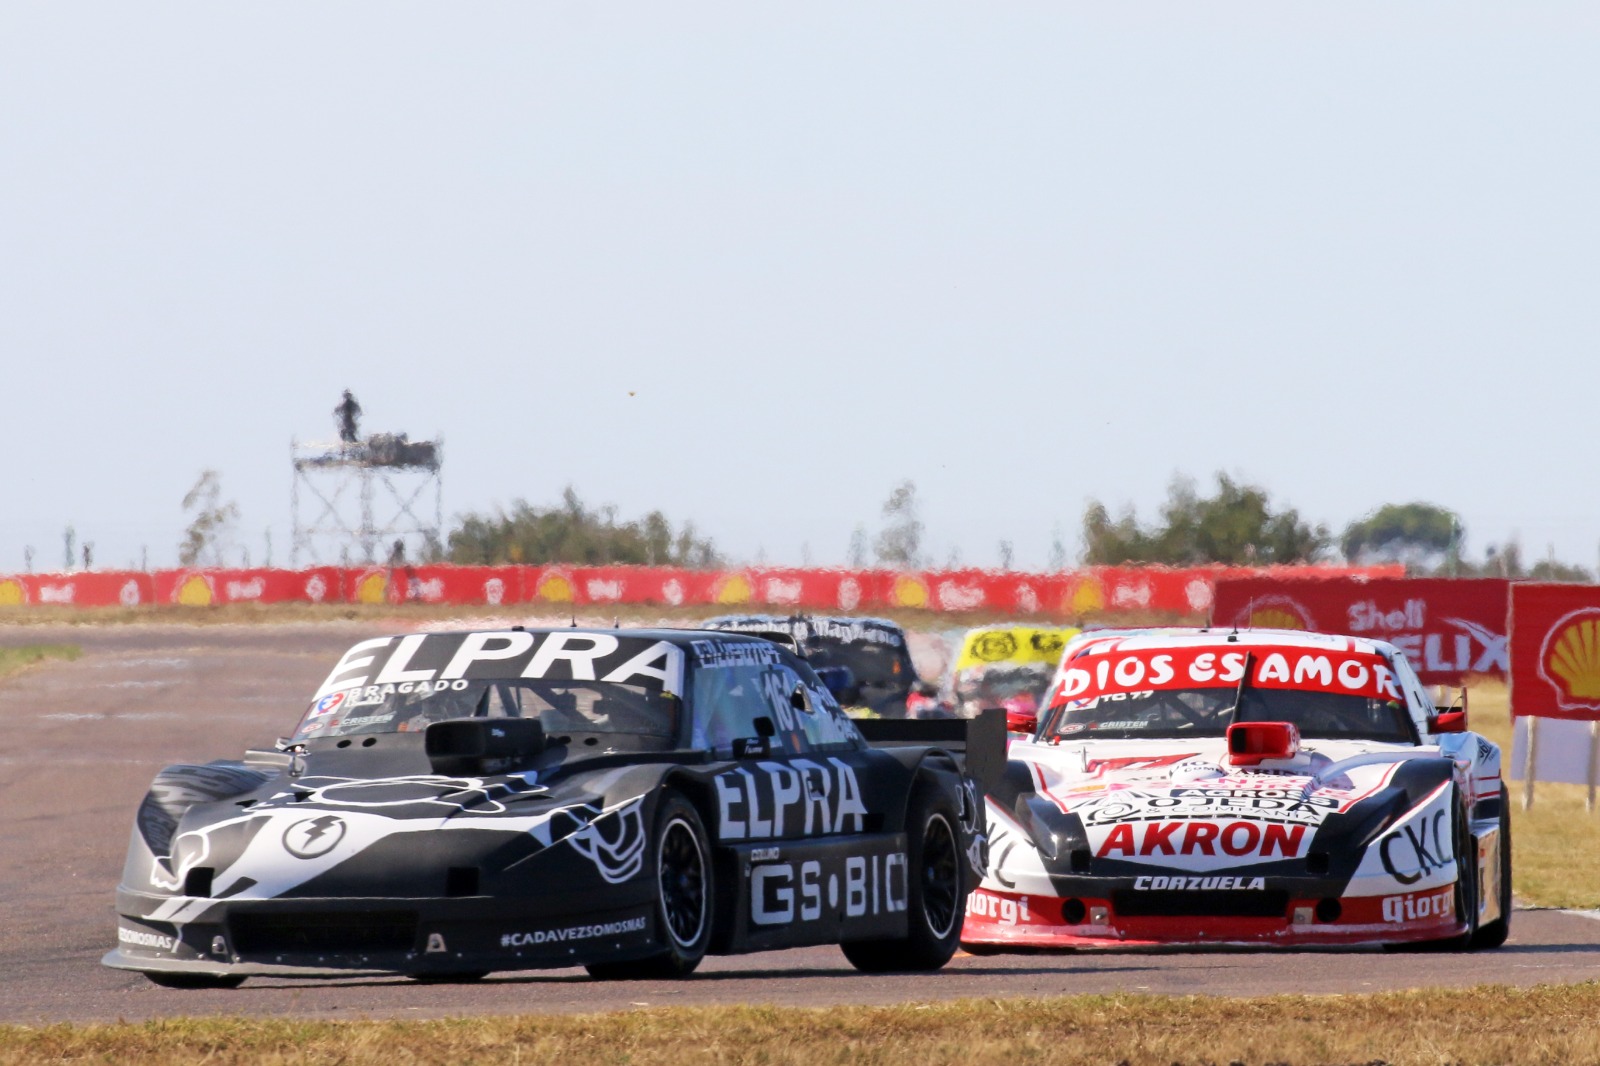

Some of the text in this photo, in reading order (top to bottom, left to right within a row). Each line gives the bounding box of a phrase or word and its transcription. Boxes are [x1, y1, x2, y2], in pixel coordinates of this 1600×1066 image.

[1348, 599, 1426, 633] Shell
[1392, 620, 1511, 672] ELIX
[311, 632, 686, 702] ELPRA
[1056, 652, 1402, 700] DIOS ES AMOR
[350, 679, 469, 698] BRAGADO
[714, 757, 868, 840] ELPRA
[1147, 797, 1321, 816] OJEDA
[1095, 821, 1307, 857] AKRON
[1379, 808, 1452, 885] CKC
[1133, 875, 1265, 891] CORZUELA
[501, 916, 646, 947] #CADAVEZSOMOSMAS
